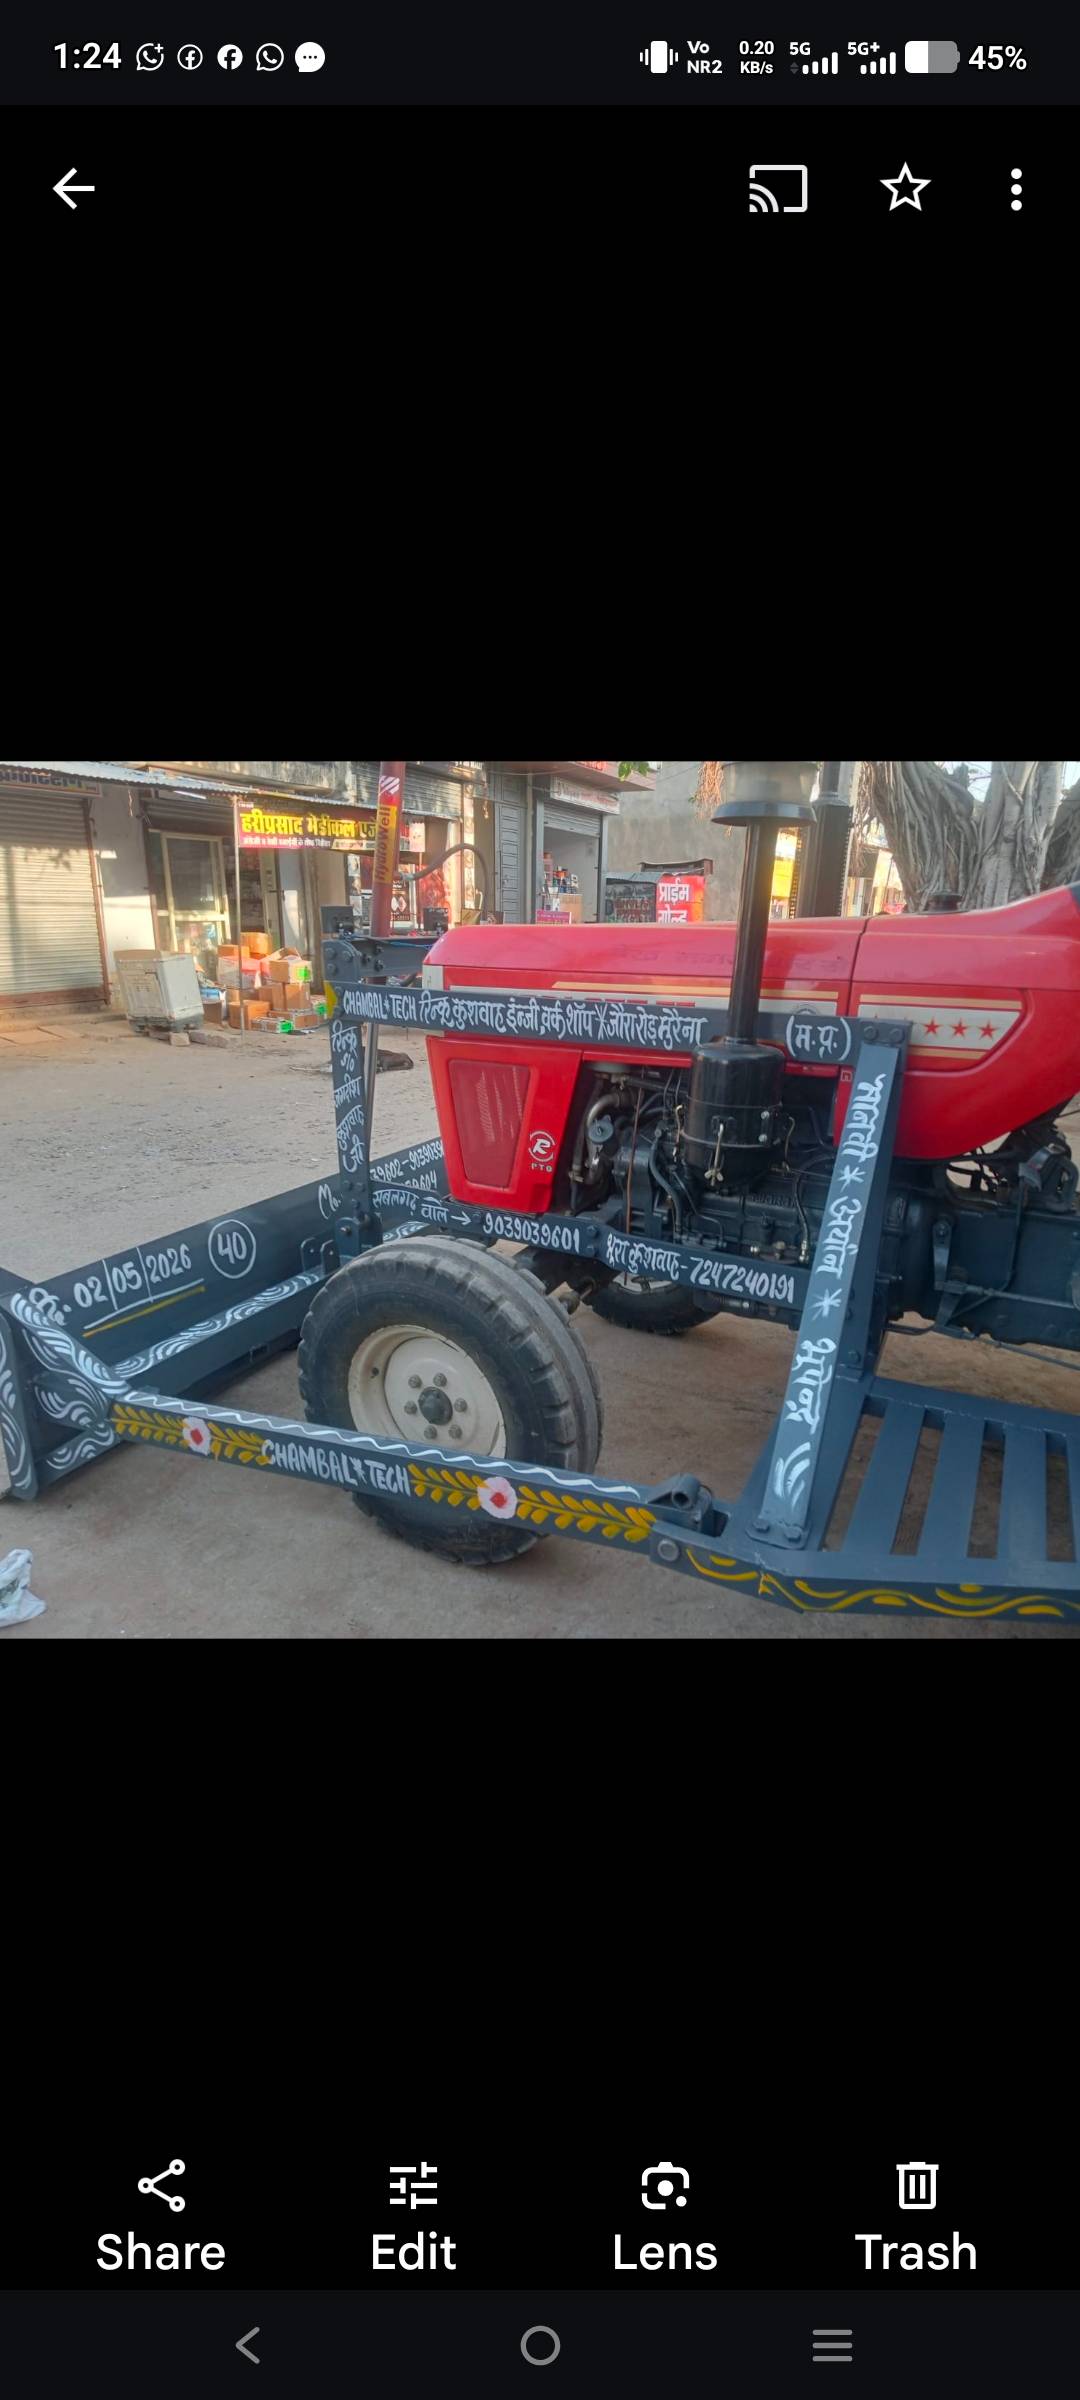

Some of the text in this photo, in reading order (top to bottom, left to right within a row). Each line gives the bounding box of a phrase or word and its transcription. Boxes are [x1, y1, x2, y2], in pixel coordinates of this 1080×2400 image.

[241, 811, 303, 837] हरीप्रसाद
[657, 878, 690, 904] प्राईम
[343, 990, 388, 1020] CHAMBAL
[389, 994, 417, 1021] TECH
[217, 1231, 248, 1264] 40
[483, 1212, 580, 1253] 9039039601
[261, 1439, 411, 1497] CHAMBAL TECH
